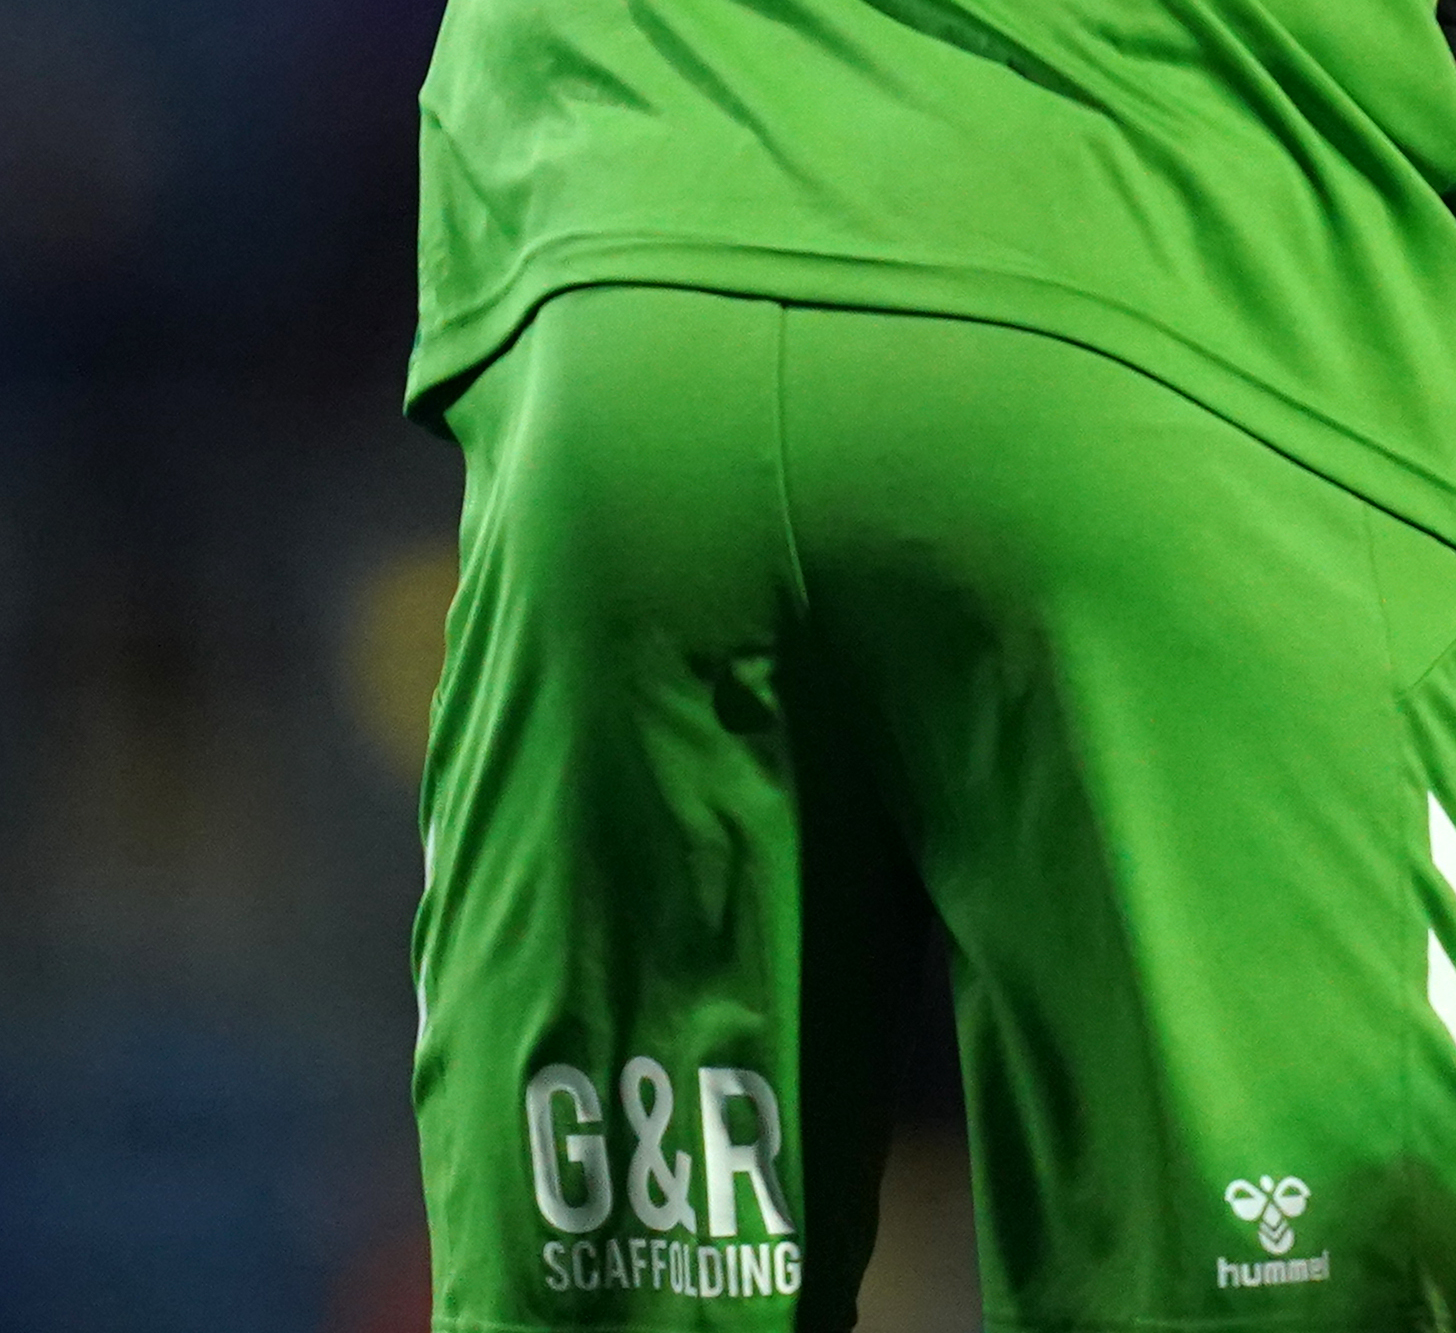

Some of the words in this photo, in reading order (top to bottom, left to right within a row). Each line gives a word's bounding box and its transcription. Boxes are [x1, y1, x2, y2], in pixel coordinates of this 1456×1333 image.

[526, 1056, 796, 1238] G&R
[543, 1239, 803, 1299] SCAFFOLDING
[1216, 1248, 1331, 1289] hummel
